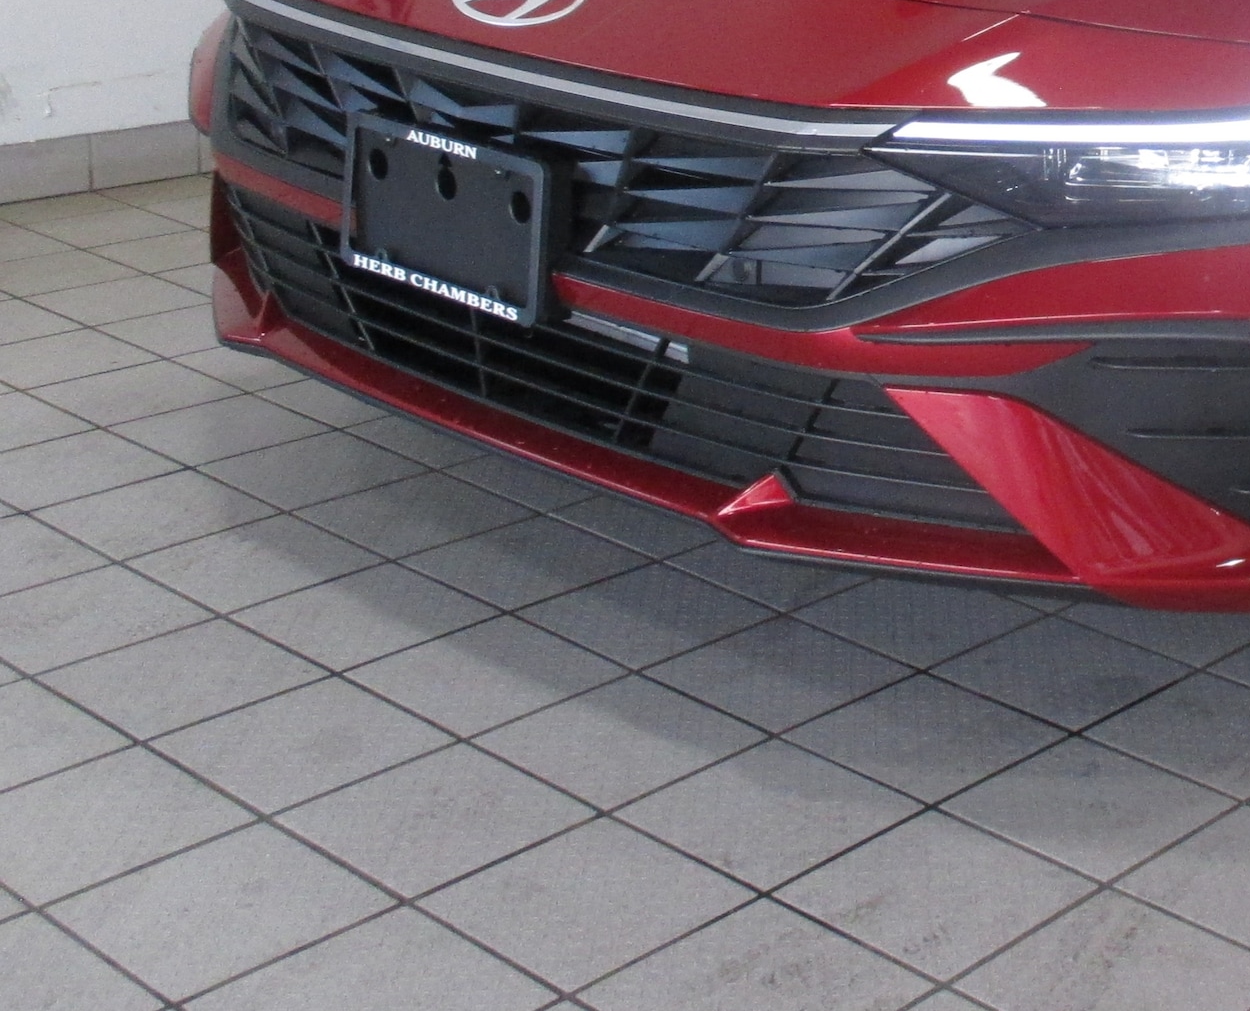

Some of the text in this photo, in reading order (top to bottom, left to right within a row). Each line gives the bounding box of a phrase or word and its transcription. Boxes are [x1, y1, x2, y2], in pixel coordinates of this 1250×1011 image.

[406, 129, 477, 159] AUBURN
[353, 253, 518, 321] HERB CHAMBERS
